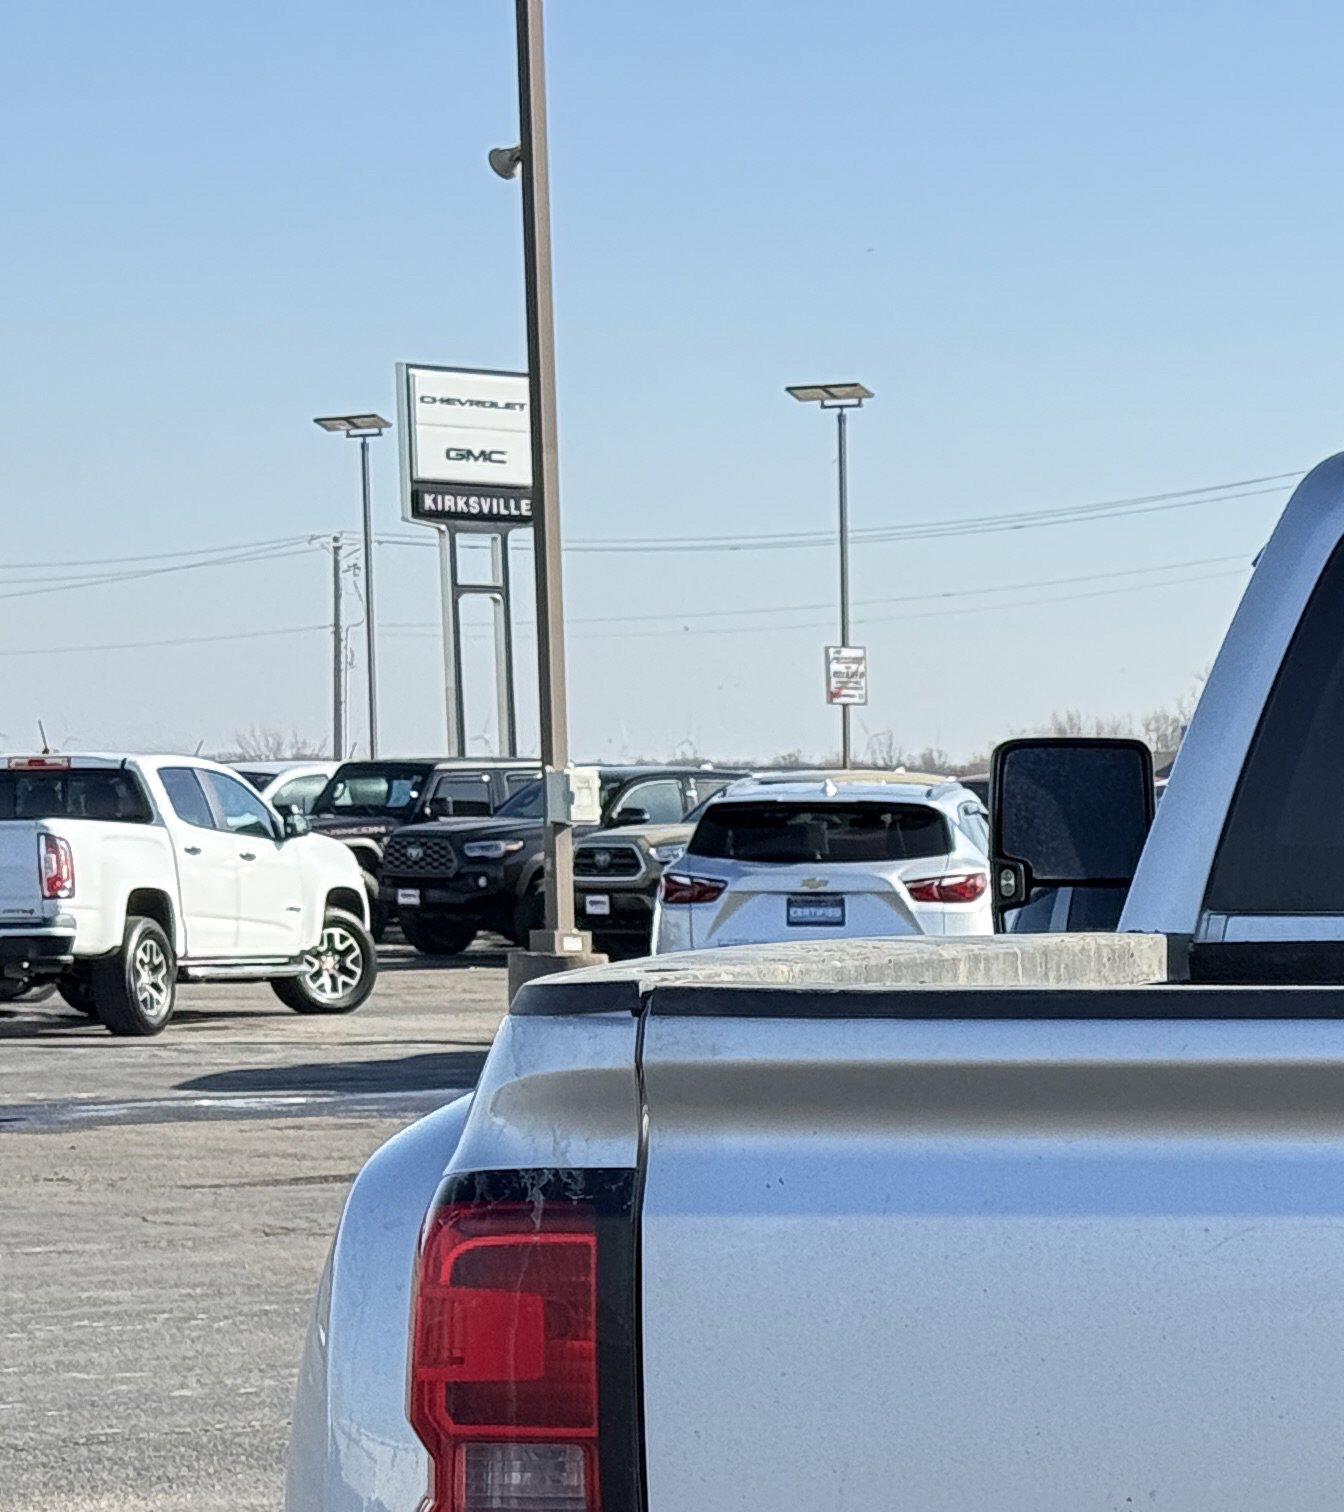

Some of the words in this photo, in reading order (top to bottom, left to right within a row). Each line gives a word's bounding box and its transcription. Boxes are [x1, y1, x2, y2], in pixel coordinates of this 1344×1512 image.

[419, 395, 528, 412] CHEVROLET
[445, 447, 508, 464] GMC
[423, 493, 533, 516] KIRKSVILLE
